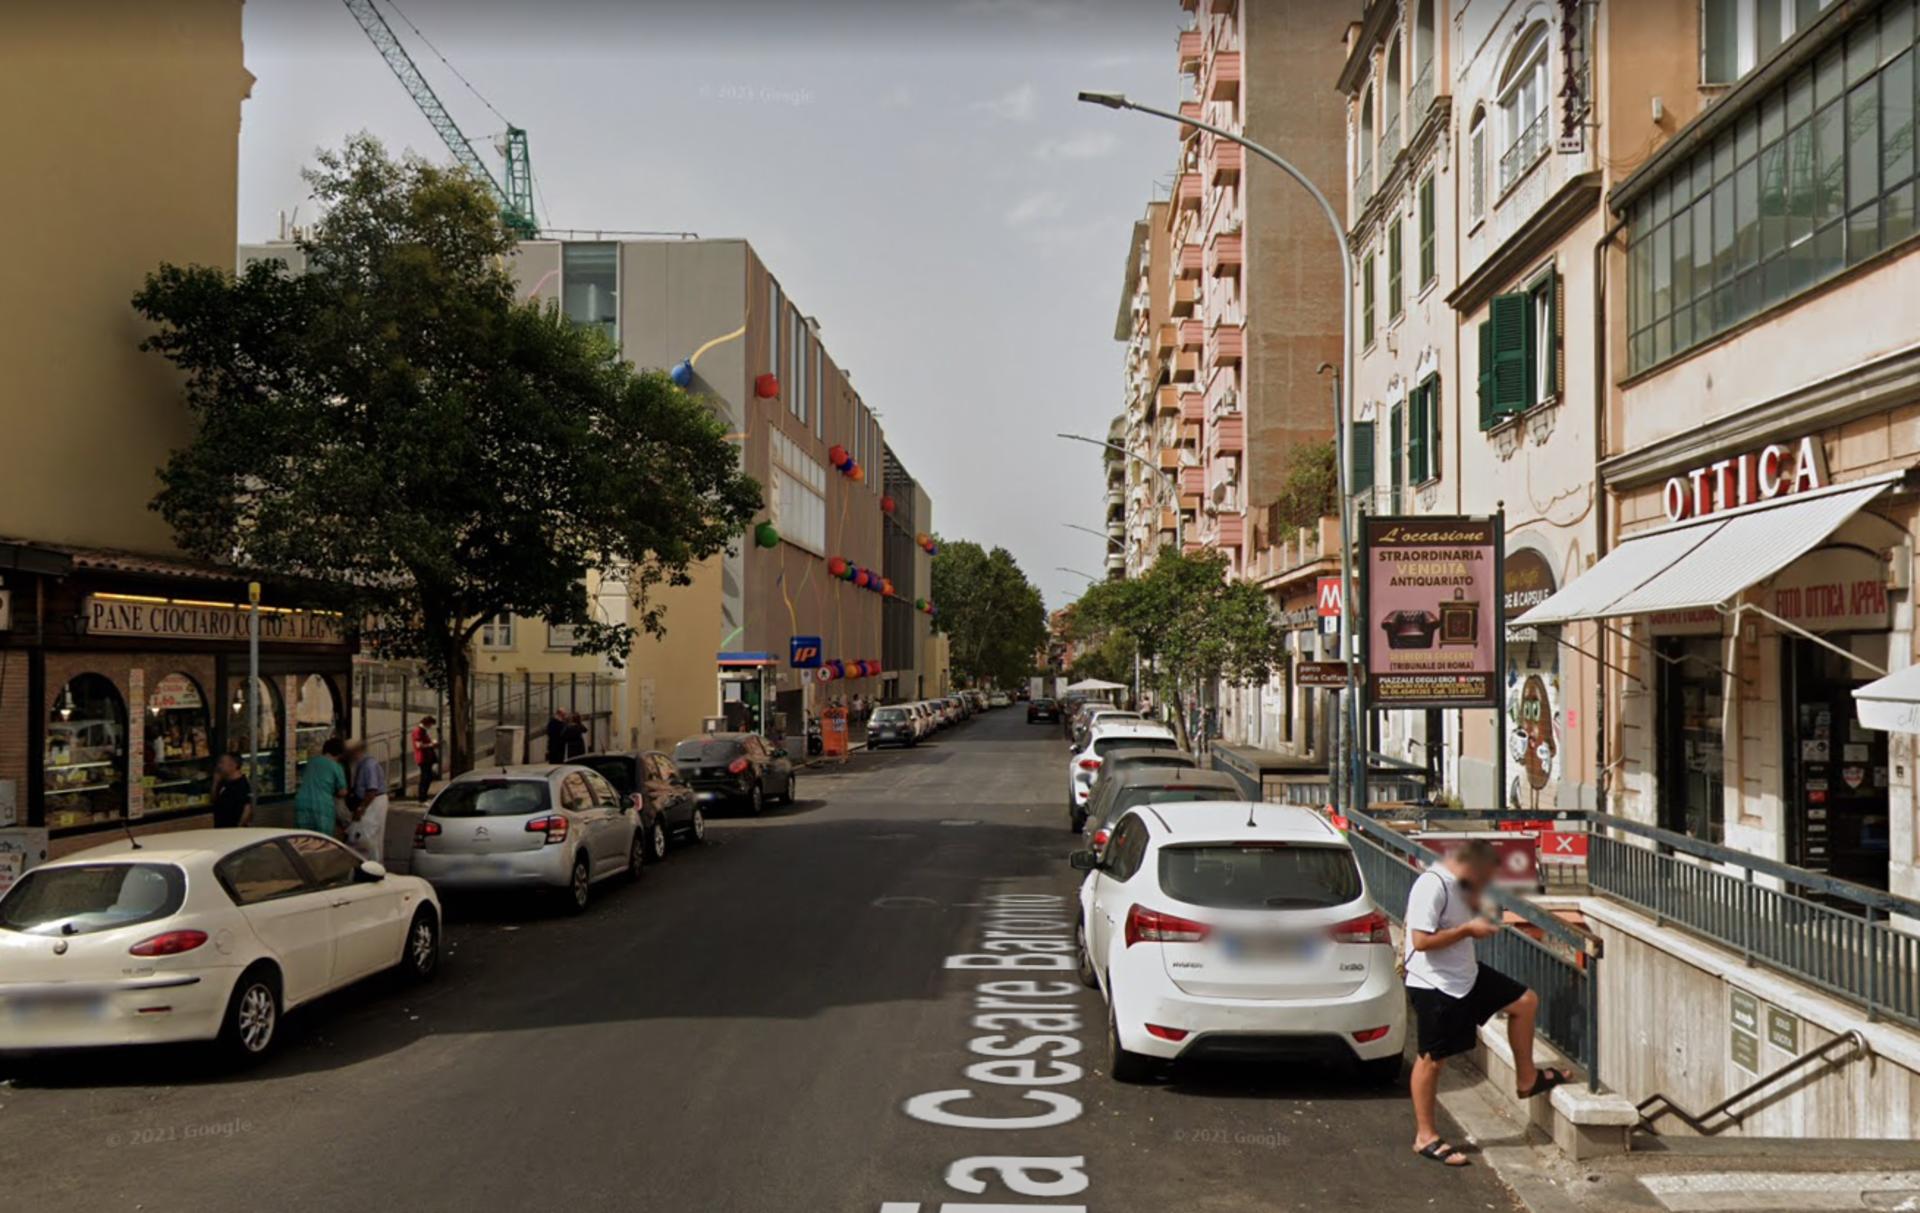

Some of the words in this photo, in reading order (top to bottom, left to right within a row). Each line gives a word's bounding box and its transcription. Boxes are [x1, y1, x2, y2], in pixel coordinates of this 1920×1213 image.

[1663, 436, 1822, 522] OTTICA
[1378, 527, 1485, 542] L'occasione
[1379, 550, 1484, 562] STRAORDINARIA
[1389, 576, 1475, 587] ANTIQUARIATO
[1396, 563, 1467, 576] VENDITA
[1320, 584, 1343, 608] M
[1776, 588, 1802, 619] FOTO
[1805, 582, 1844, 617] OTTICA
[1850, 579, 1888, 616] APPIA
[93, 602, 143, 632] PANE
[150, 607, 230, 635] CIOCIARO
[288, 616, 296, 637] A
[301, 617, 343, 640] LEGN
[793, 647, 817, 662] IP
[943, 894, 1078, 970] Baronio
[903, 980, 1084, 1129] Cesare
